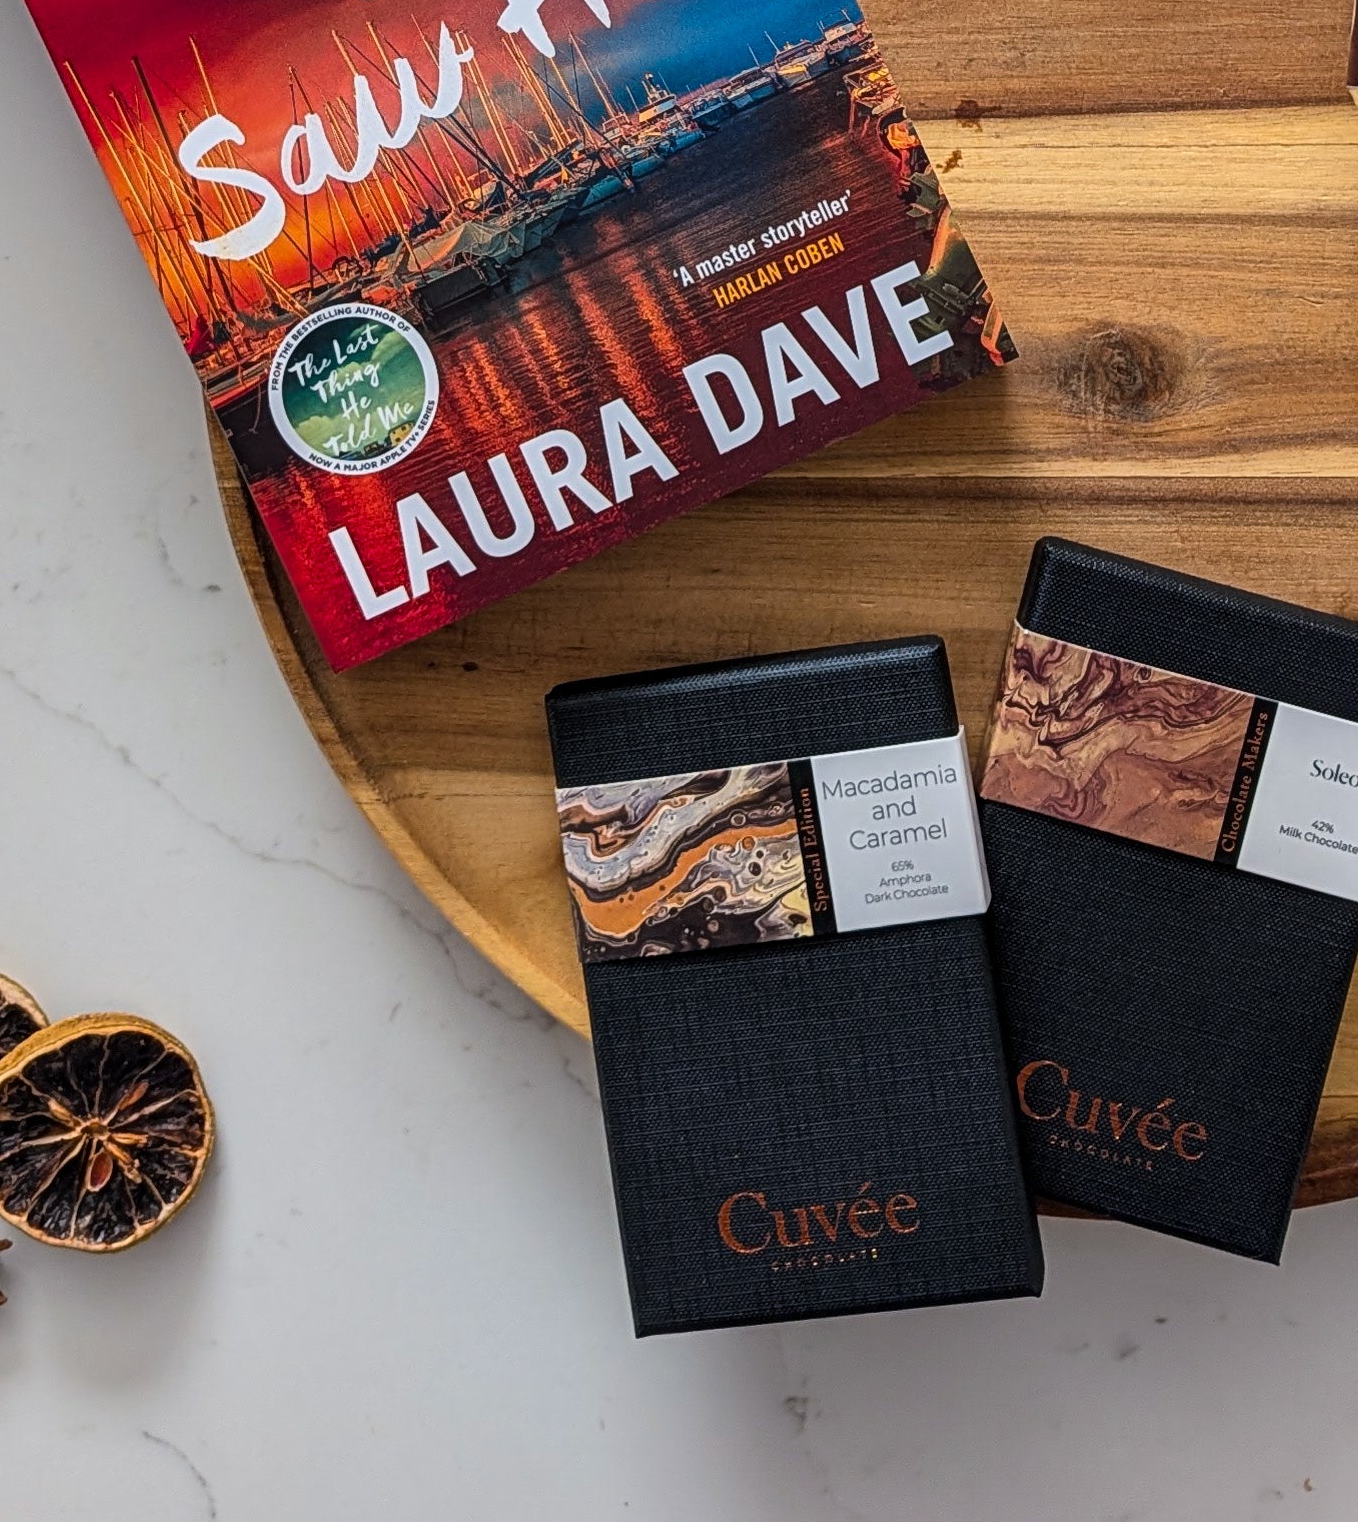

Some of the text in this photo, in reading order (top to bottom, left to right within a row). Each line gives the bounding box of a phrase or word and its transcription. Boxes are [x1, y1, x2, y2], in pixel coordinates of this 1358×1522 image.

[187, 20, 474, 260] Saw
[695, 238, 757, 279] master
[712, 232, 845, 308] HARLAN COBEN
[271, 307, 411, 390] FROM THE BESTSELLING AUTHOR OF
[289, 323, 379, 387] The Last
[310, 362, 380, 403] Thing
[341, 391, 371, 420] He
[309, 453, 332, 468] NOW
[334, 462, 341, 471] A
[344, 460, 378, 471] MAJOR
[380, 444, 406, 466] APPLE
[419, 400, 435, 431] SERIES
[323, 402, 414, 456] Told Me
[328, 261, 955, 620] LAURA DAVE
[822, 762, 957, 799] Macadamia
[1221, 711, 1267, 854] Chocolate Makers
[872, 795, 917, 820] and
[1311, 818, 1334, 834] 42%
[799, 788, 830, 912] Special Edition
[849, 818, 947, 850] Caramel
[1279, 825, 1358, 855] Milk Chocolate
[879, 872, 931, 888] Amphora
[891, 860, 914, 872] 65%
[865, 884, 948, 904] Dark Chocolate
[1016, 1060, 1208, 1161] Cuvée
[717, 1181, 920, 1254] Cuvée
